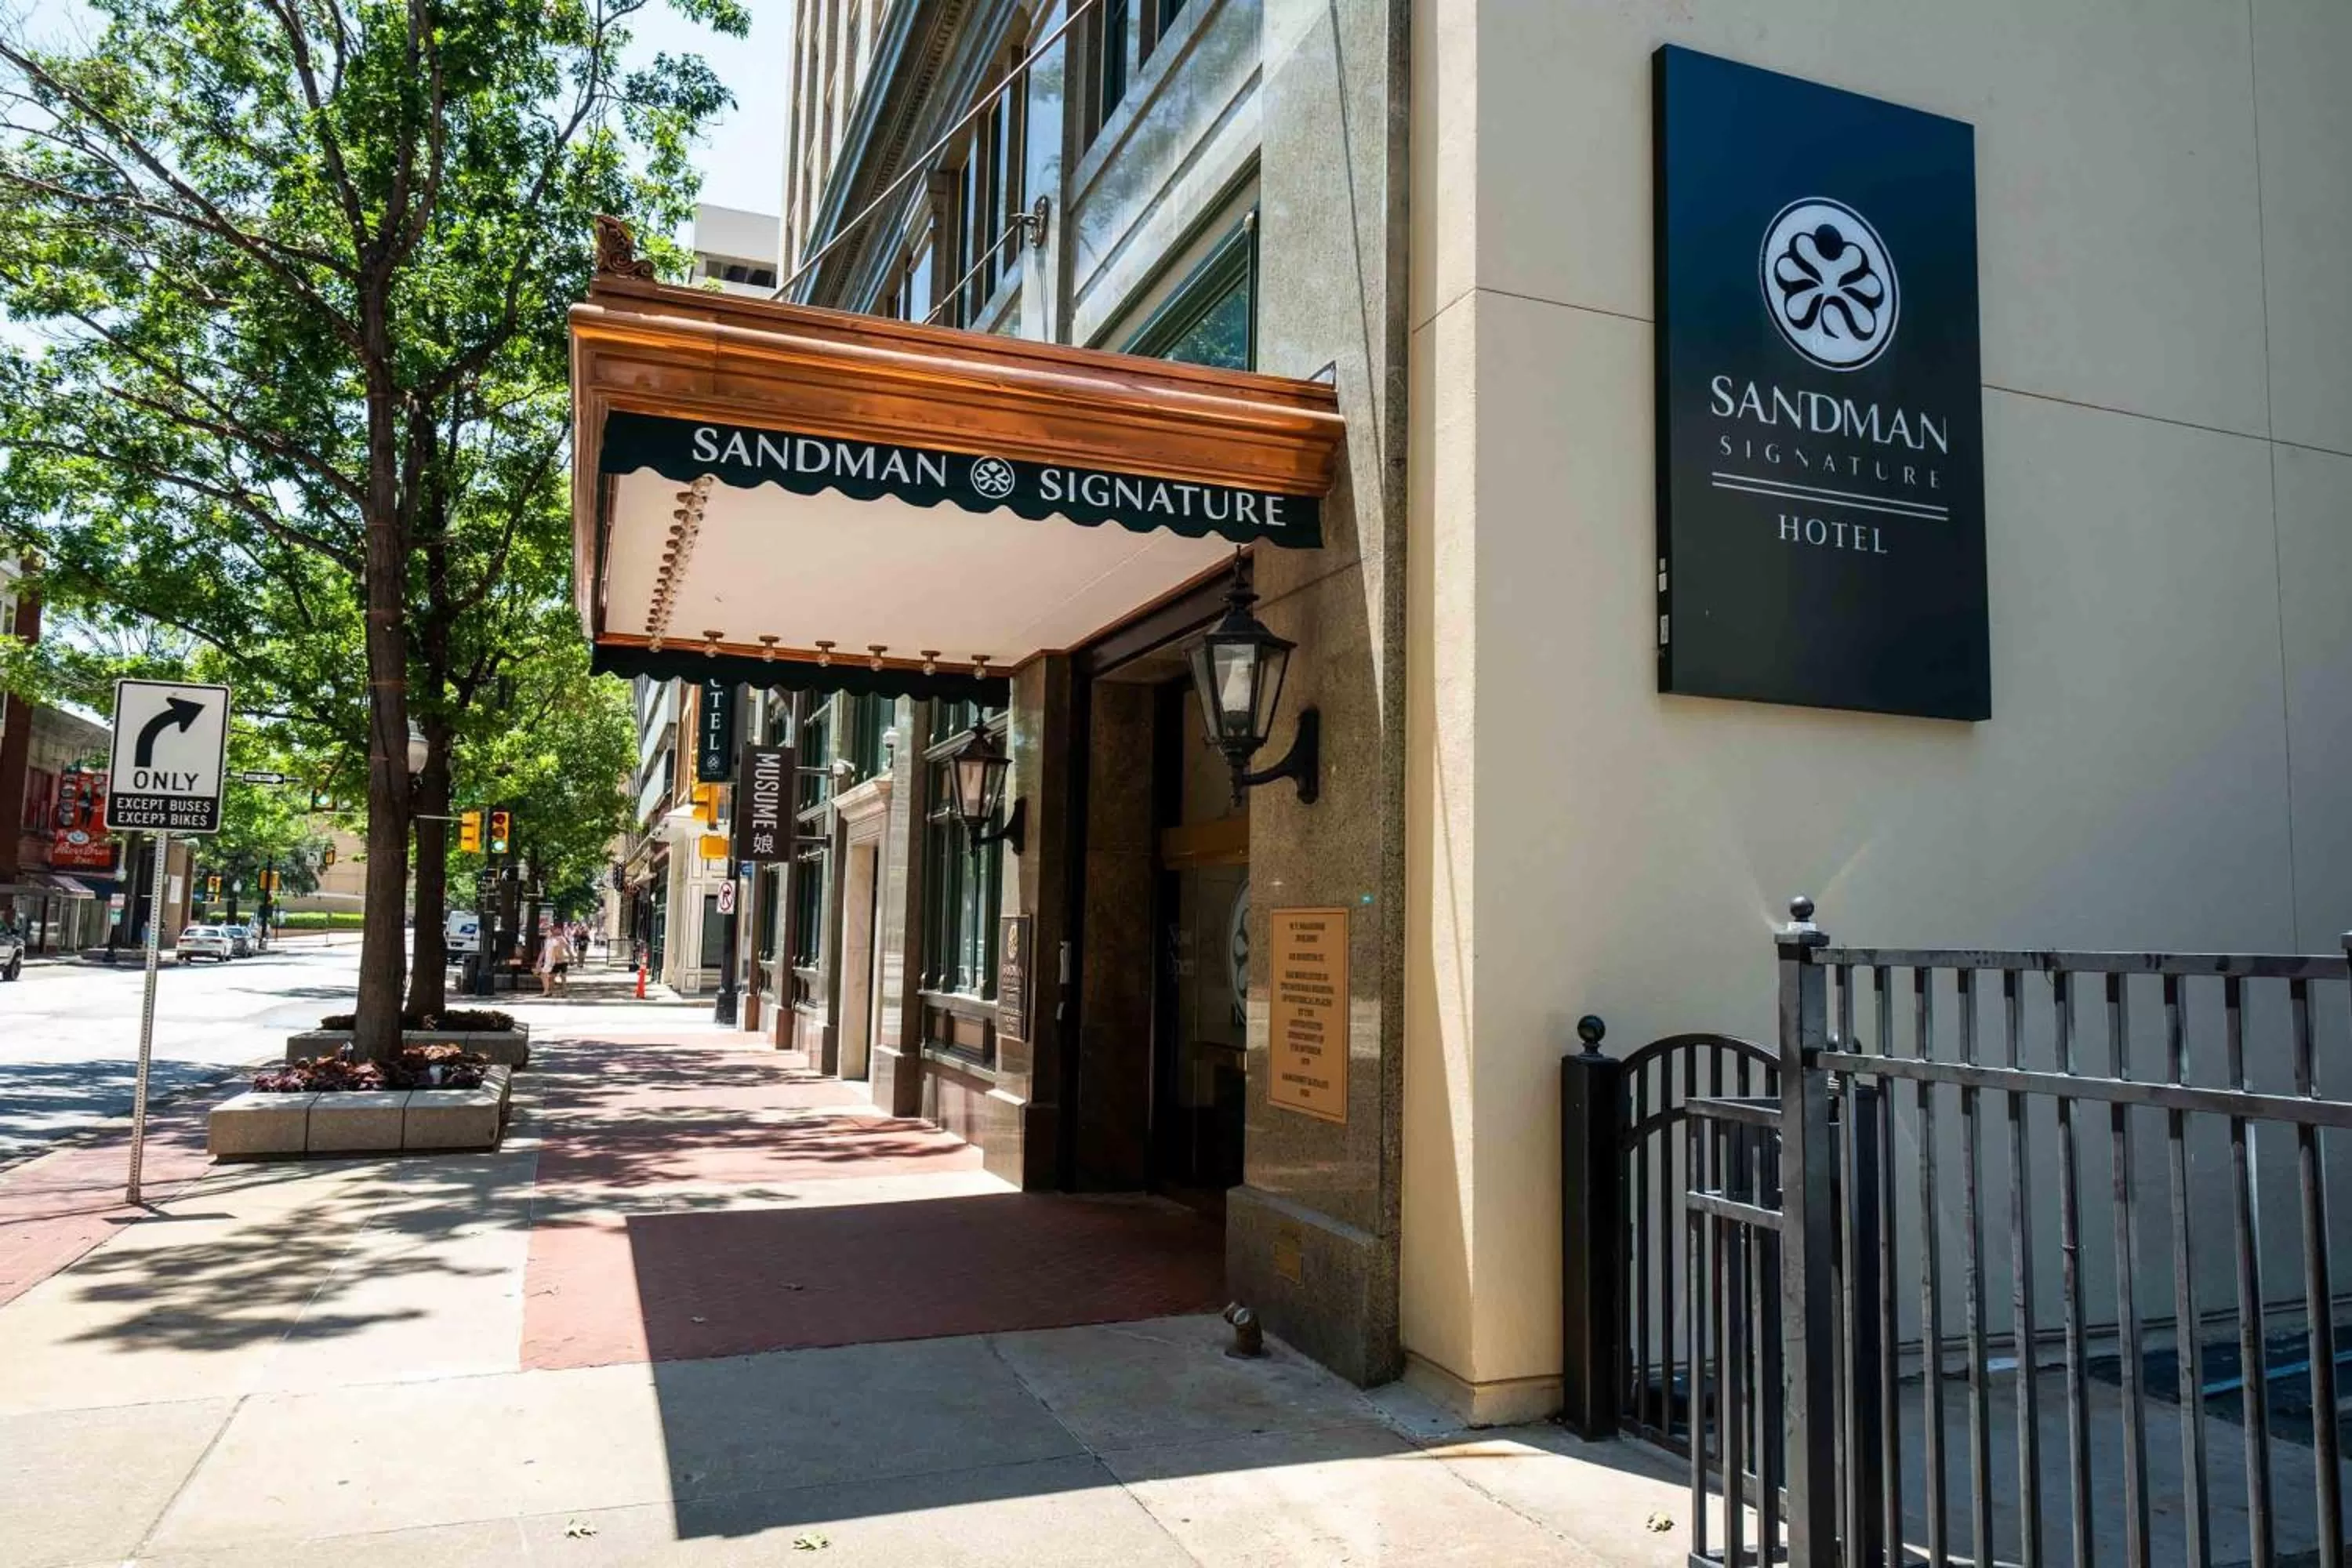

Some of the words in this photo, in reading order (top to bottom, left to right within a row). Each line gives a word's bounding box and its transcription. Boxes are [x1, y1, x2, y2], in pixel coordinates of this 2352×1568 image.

[1711, 375, 1948, 455] SANDMAN
[692, 429, 946, 488] SANDMAN
[1039, 468, 1287, 527] SIGNATURE
[1719, 434, 1940, 489] SIGNATURE
[1778, 514, 1888, 554] HOTEL
[134, 771, 199, 791] ONLY
[753, 753, 782, 829] MUSUME
[117, 797, 165, 810] EXCEPT
[169, 800, 211, 813] BUSES
[118, 812, 166, 824] EXCEPT
[170, 814, 208, 827] BIKES
[753, 833, 775, 854] 娘
